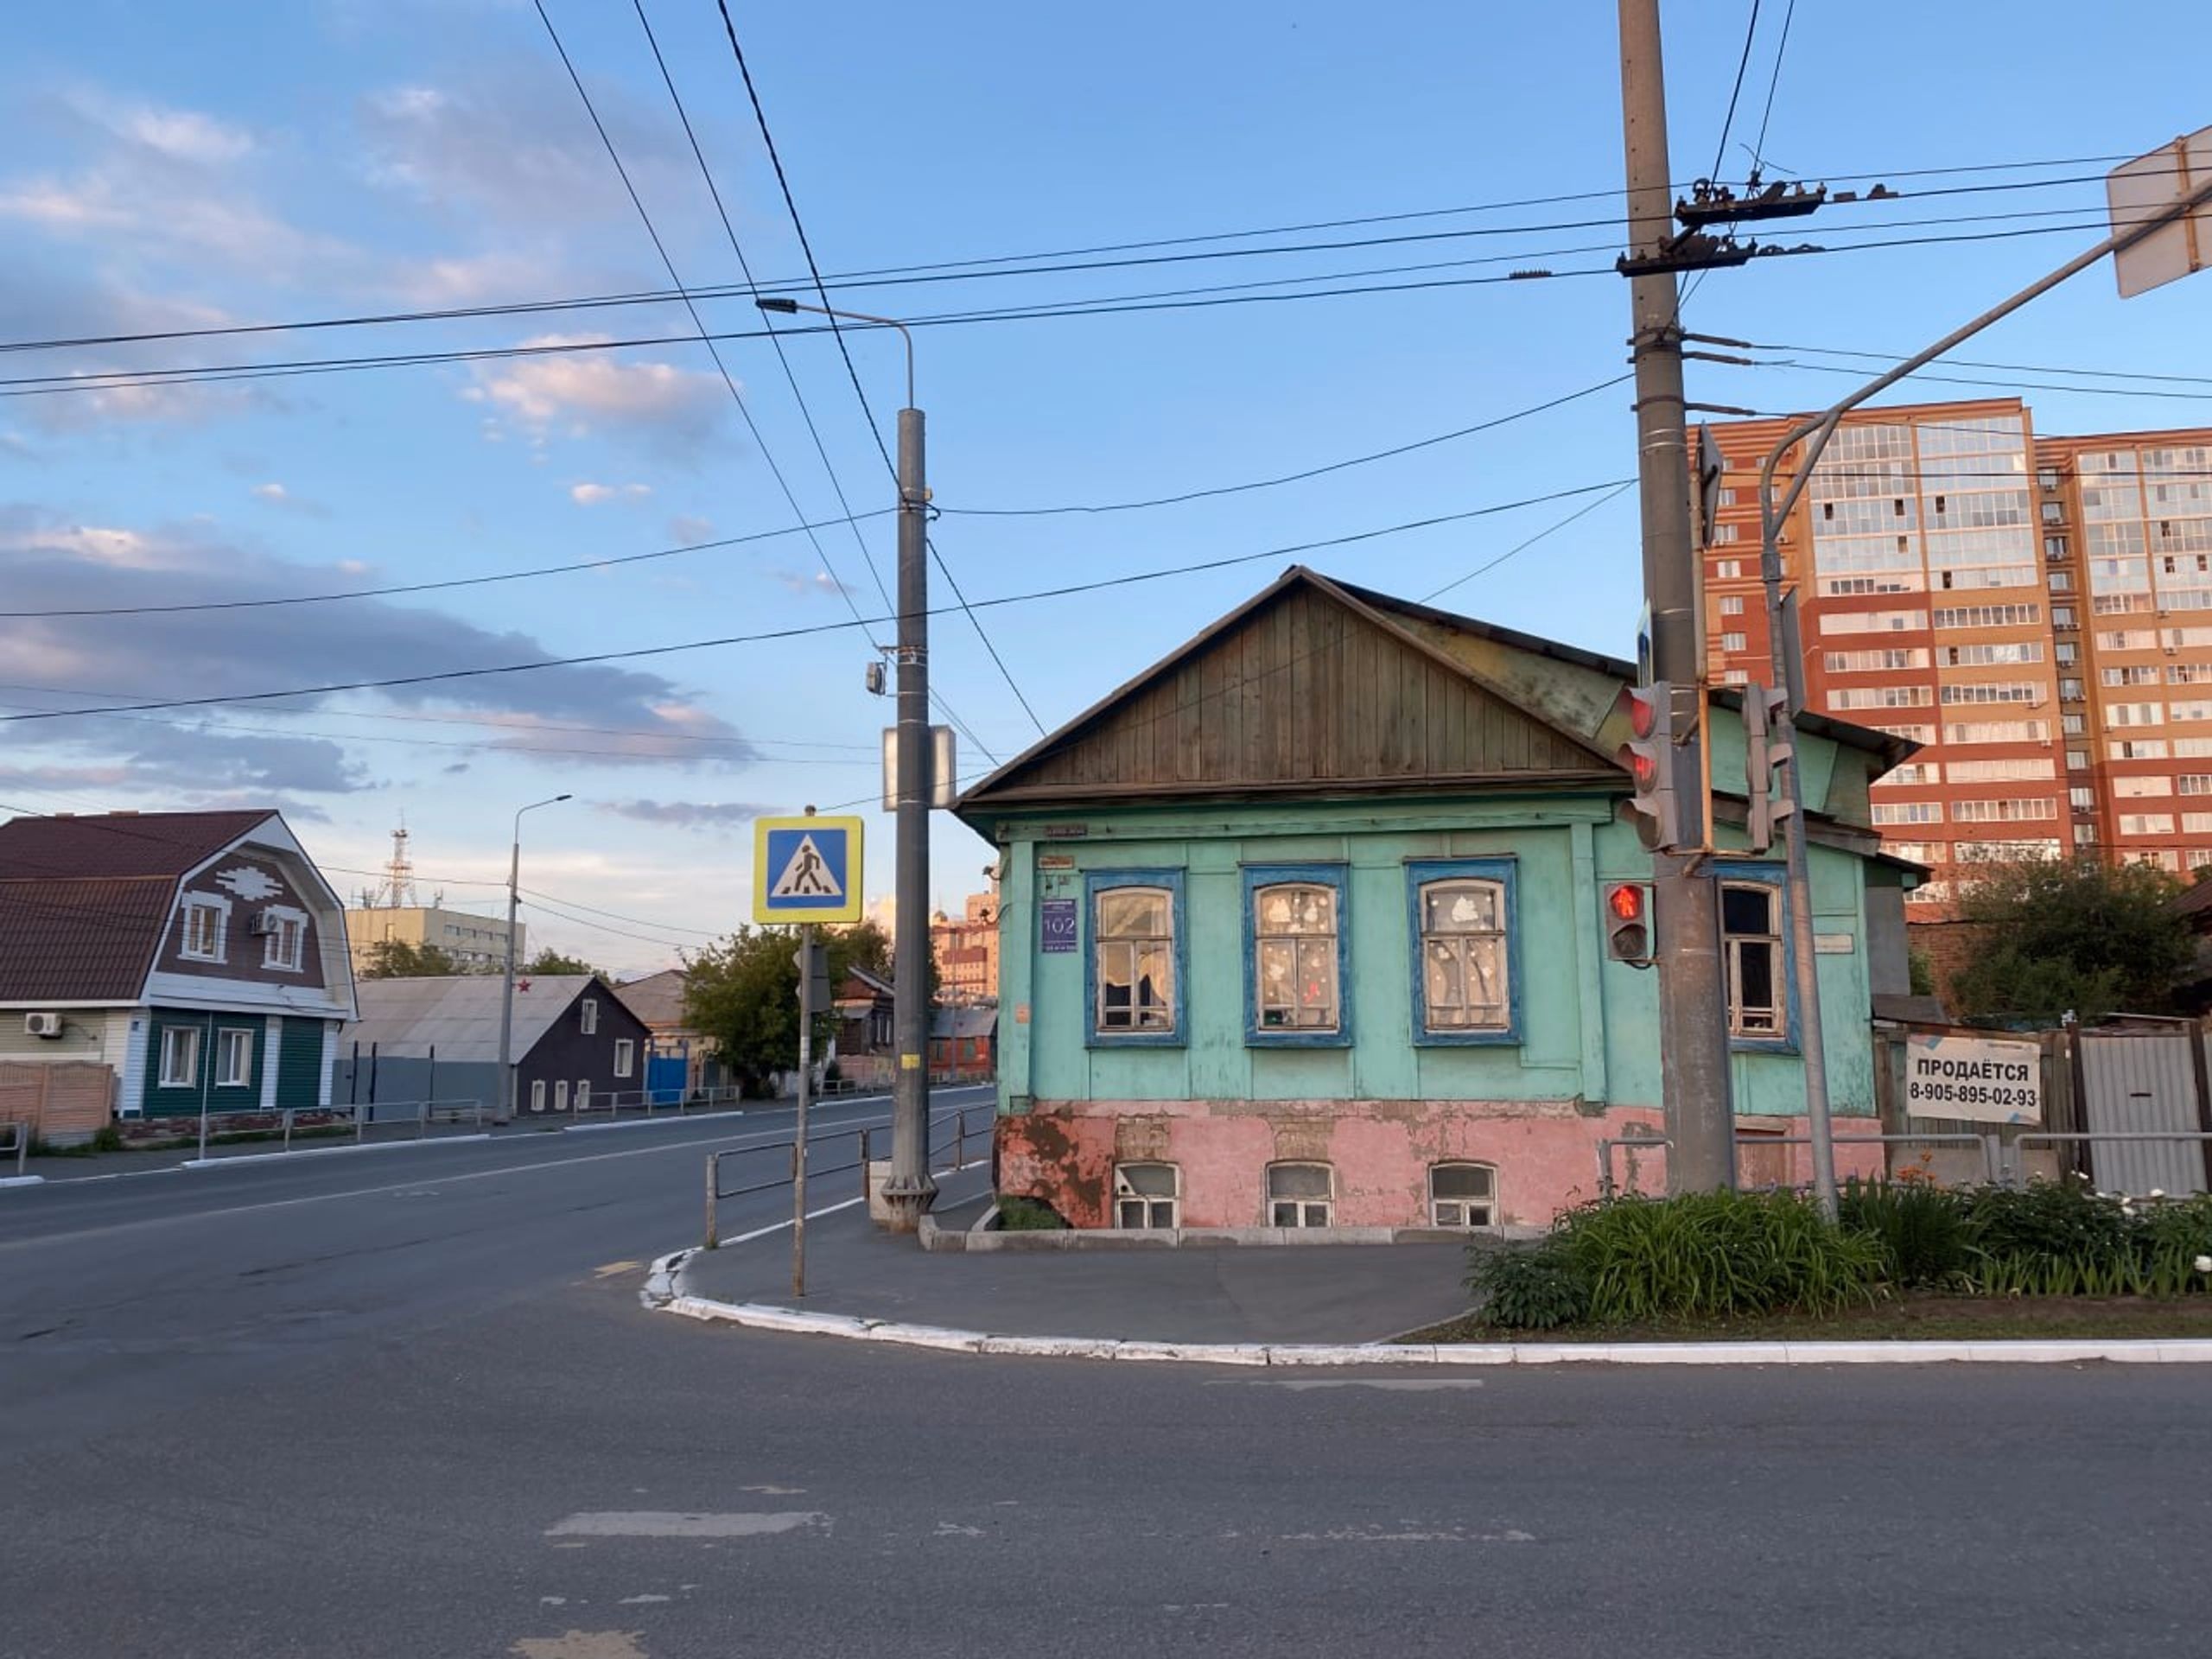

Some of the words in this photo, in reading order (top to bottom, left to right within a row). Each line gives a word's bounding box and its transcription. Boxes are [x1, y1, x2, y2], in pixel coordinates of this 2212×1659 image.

[1044, 918, 1074, 934] 102
[1917, 1058, 2028, 1081] ПРОДАЁТСЯ
[1910, 1082, 2036, 1107] 8-905-895-02-93
